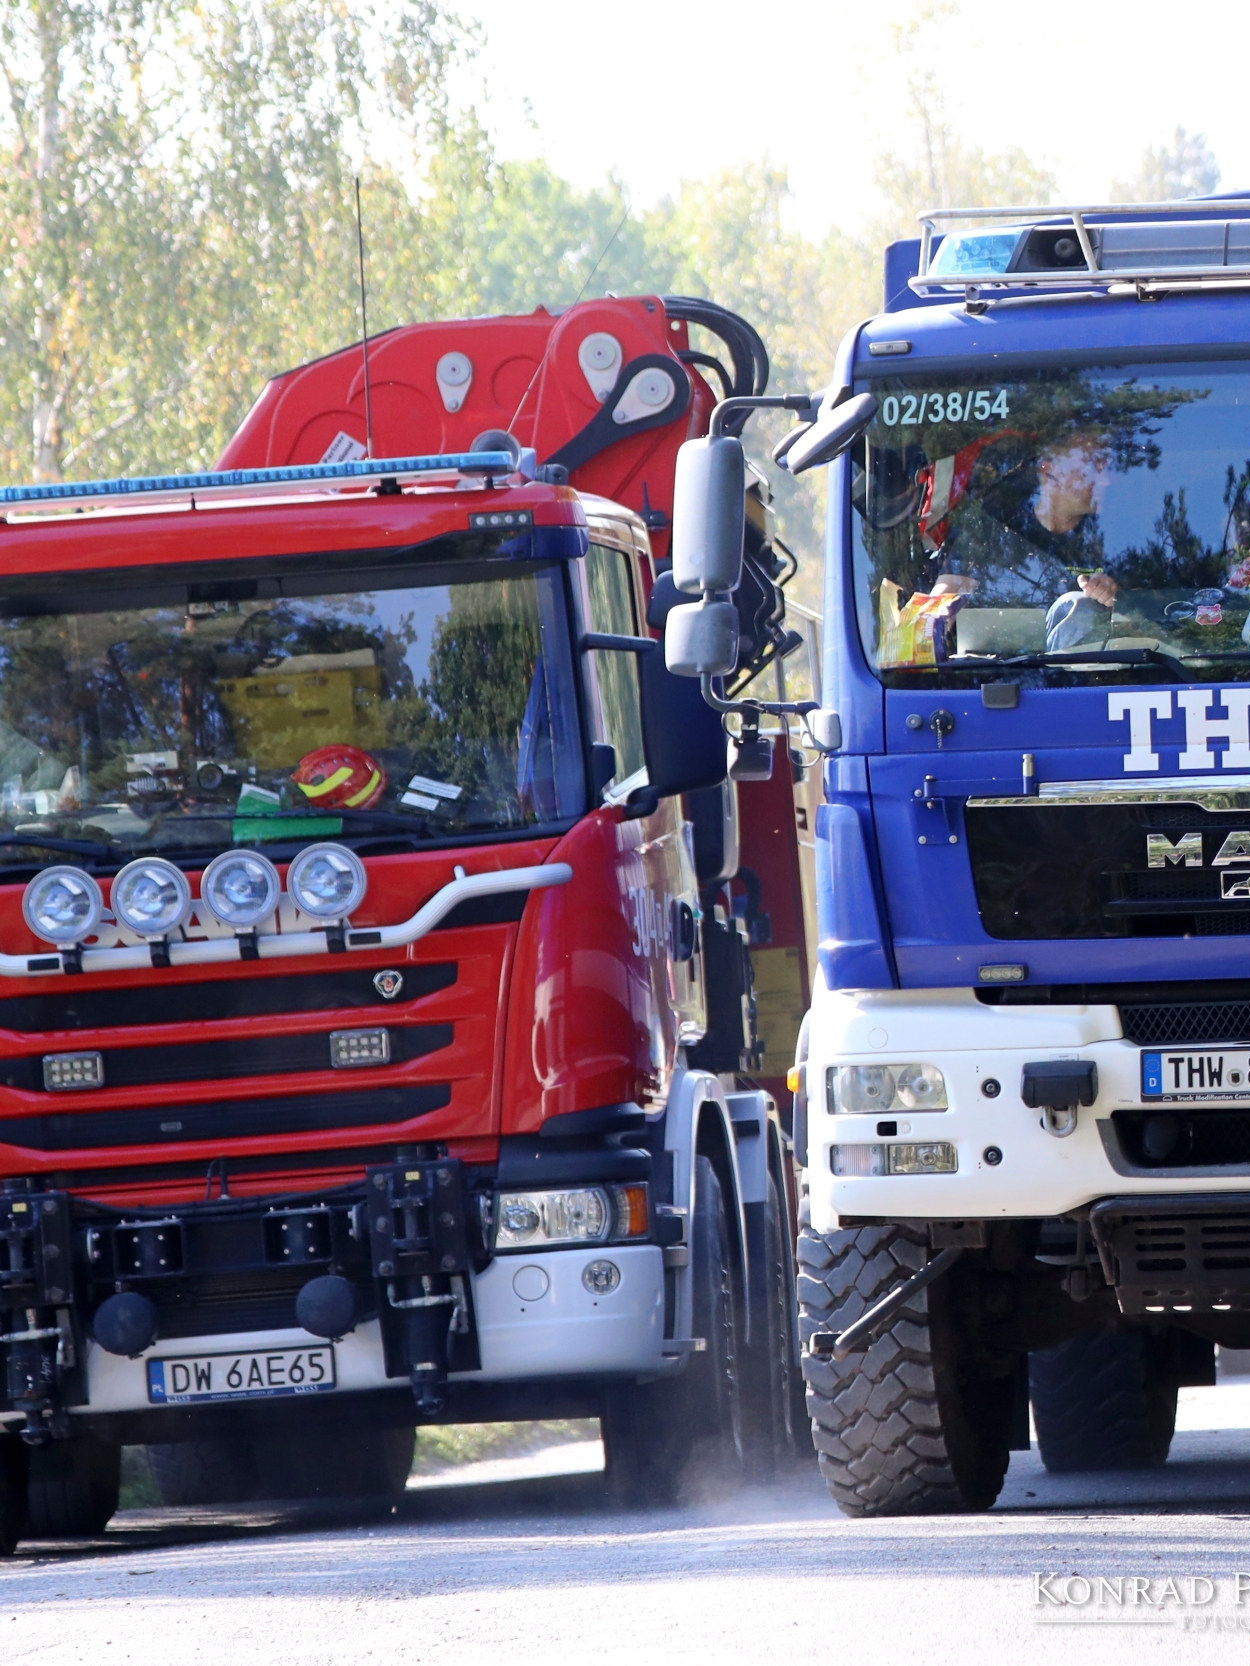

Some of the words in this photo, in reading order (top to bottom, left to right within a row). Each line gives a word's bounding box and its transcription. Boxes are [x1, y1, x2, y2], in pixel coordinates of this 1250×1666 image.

[882, 389, 1010, 426] 02/38/54
[1149, 1077, 1157, 1087] D
[1168, 1056, 1223, 1088] THW
[152, 1384, 163, 1393] PL
[171, 1361, 212, 1393] DW
[226, 1352, 325, 1388] 6AE65
